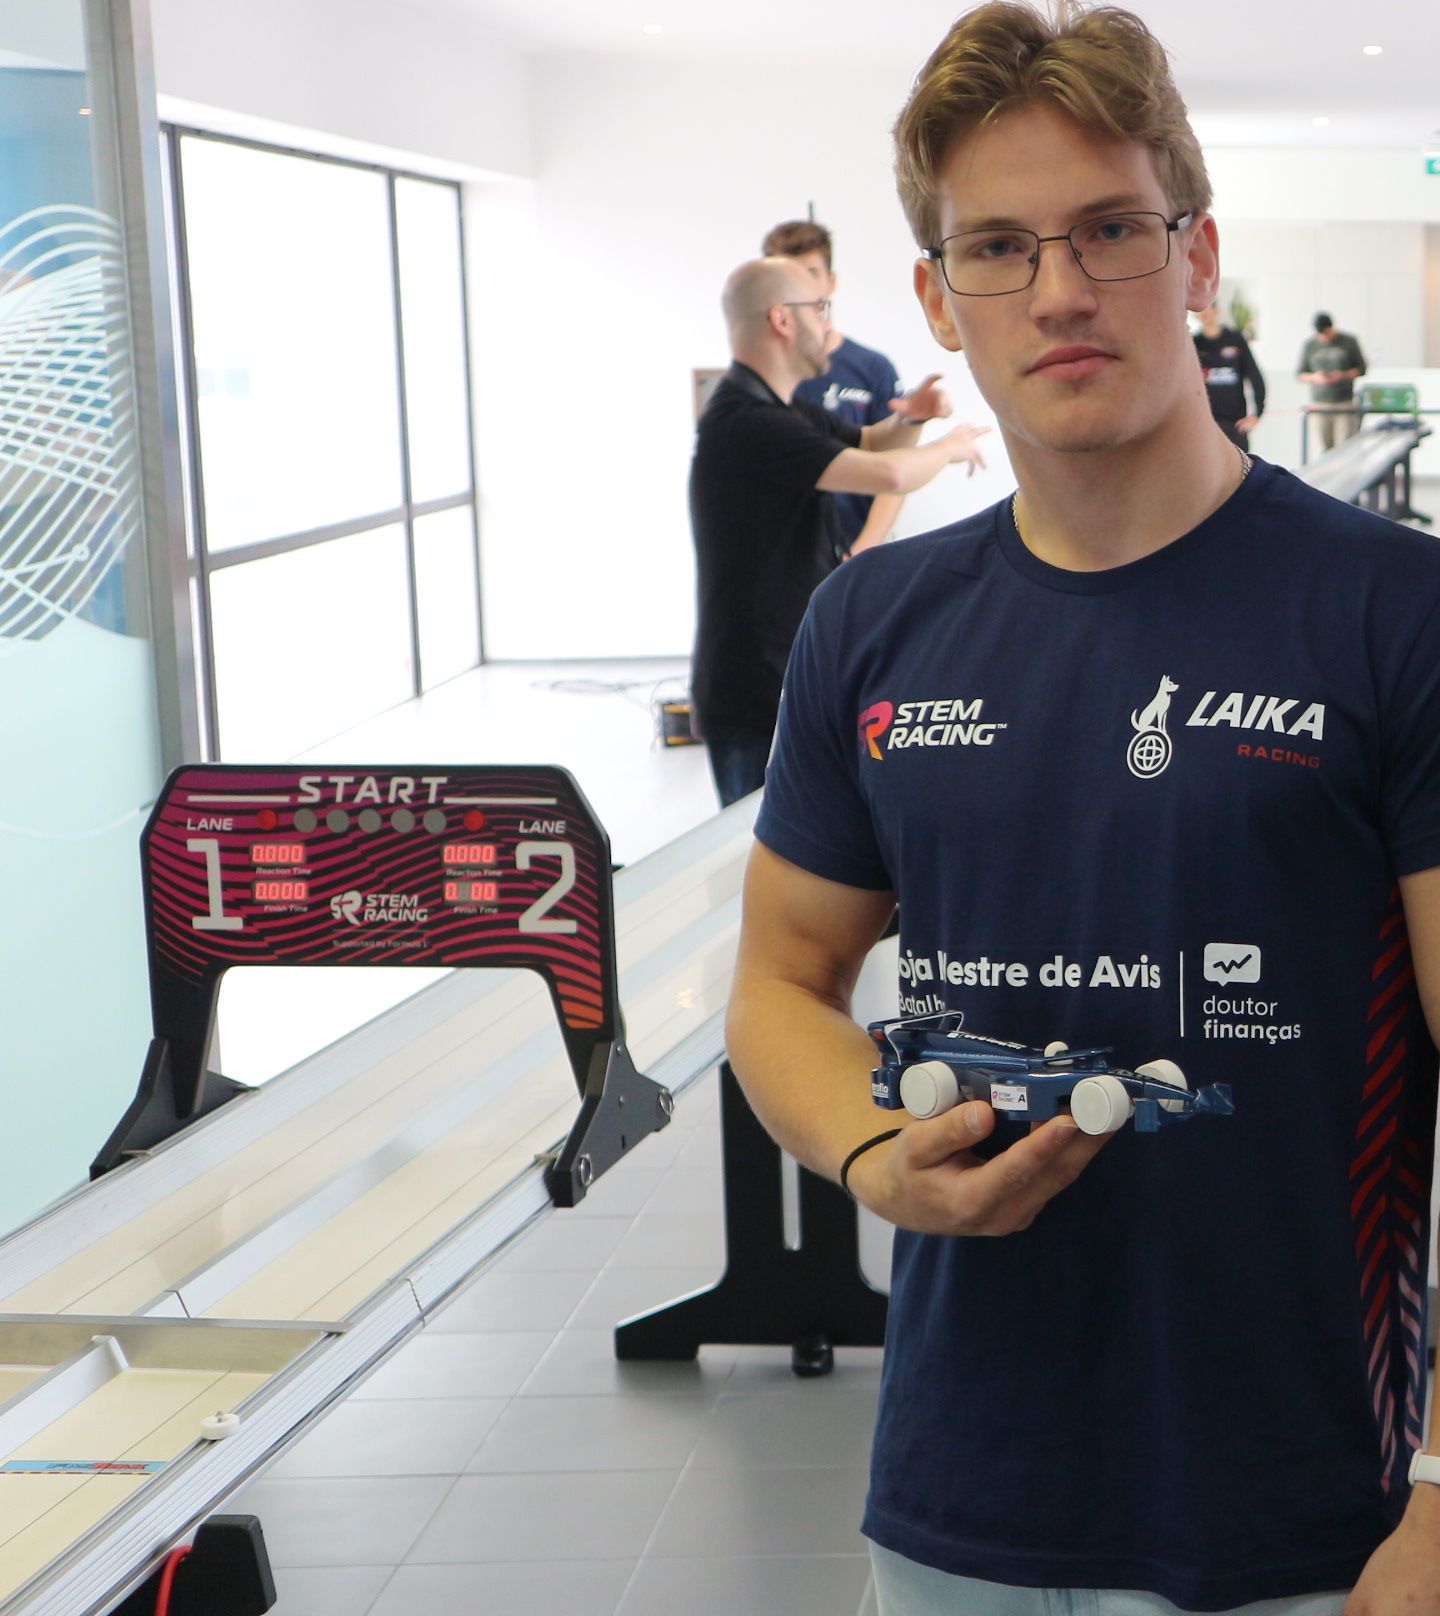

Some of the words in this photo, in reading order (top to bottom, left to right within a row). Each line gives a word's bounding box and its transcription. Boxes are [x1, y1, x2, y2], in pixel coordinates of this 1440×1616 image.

[893, 698, 984, 724] STEM
[1185, 691, 1326, 741] LAIKA
[1238, 744, 1321, 769] RACING
[297, 775, 448, 804] START
[186, 817, 233, 831] LANE
[518, 820, 566, 834] LANE
[293, 867, 312, 875] Time
[483, 869, 503, 877] Time
[186, 838, 244, 930] 1
[515, 841, 578, 934] 2
[263, 904, 288, 913] Finish
[289, 904, 309, 912] Time
[366, 894, 419, 908] STEM
[453, 906, 478, 914] Finish
[480, 906, 499, 914] Time
[363, 908, 429, 922] RACING
[898, 949, 934, 988] oja
[1039, 955, 1082, 988] de
[1088, 954, 1162, 989] Avis
[898, 991, 946, 1016] Batalh
[1203, 994, 1278, 1017] doutor
[1203, 1018, 1302, 1046] finanças
[1017, 1094, 1026, 1103] A
